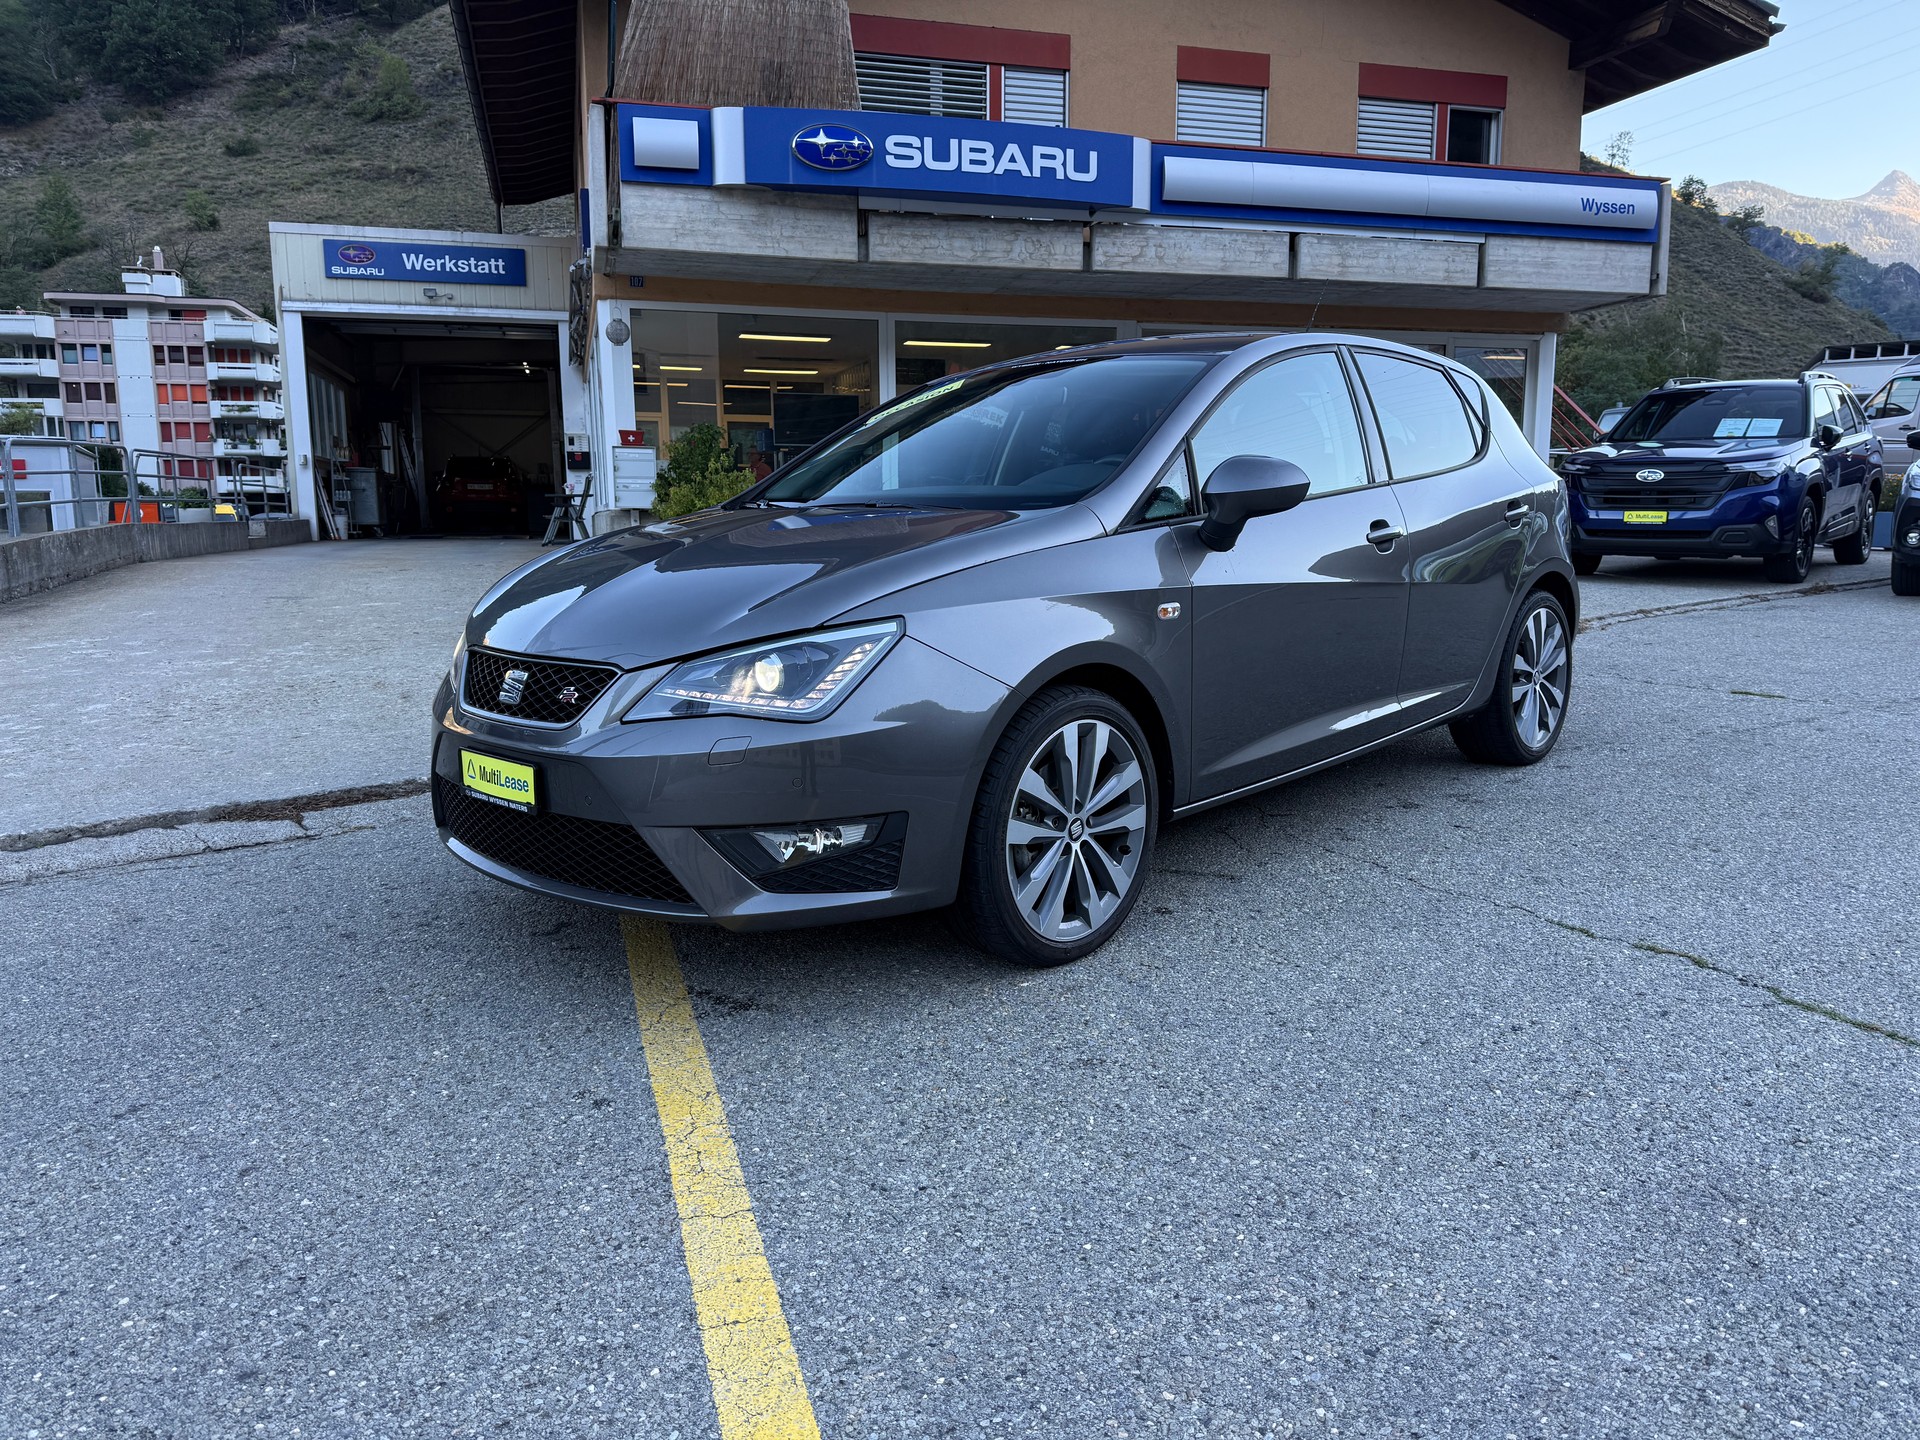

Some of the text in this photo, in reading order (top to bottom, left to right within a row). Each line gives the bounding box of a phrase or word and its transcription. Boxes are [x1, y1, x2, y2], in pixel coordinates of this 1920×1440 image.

[885, 134, 1098, 182] SUBARU
[1581, 197, 1635, 216] Wyssen
[331, 266, 384, 276] SUBARU
[402, 253, 505, 274] Werkstatt
[479, 764, 529, 793] MultiLease
[471, 791, 528, 812] SUBARU WYSSEN NATERS
